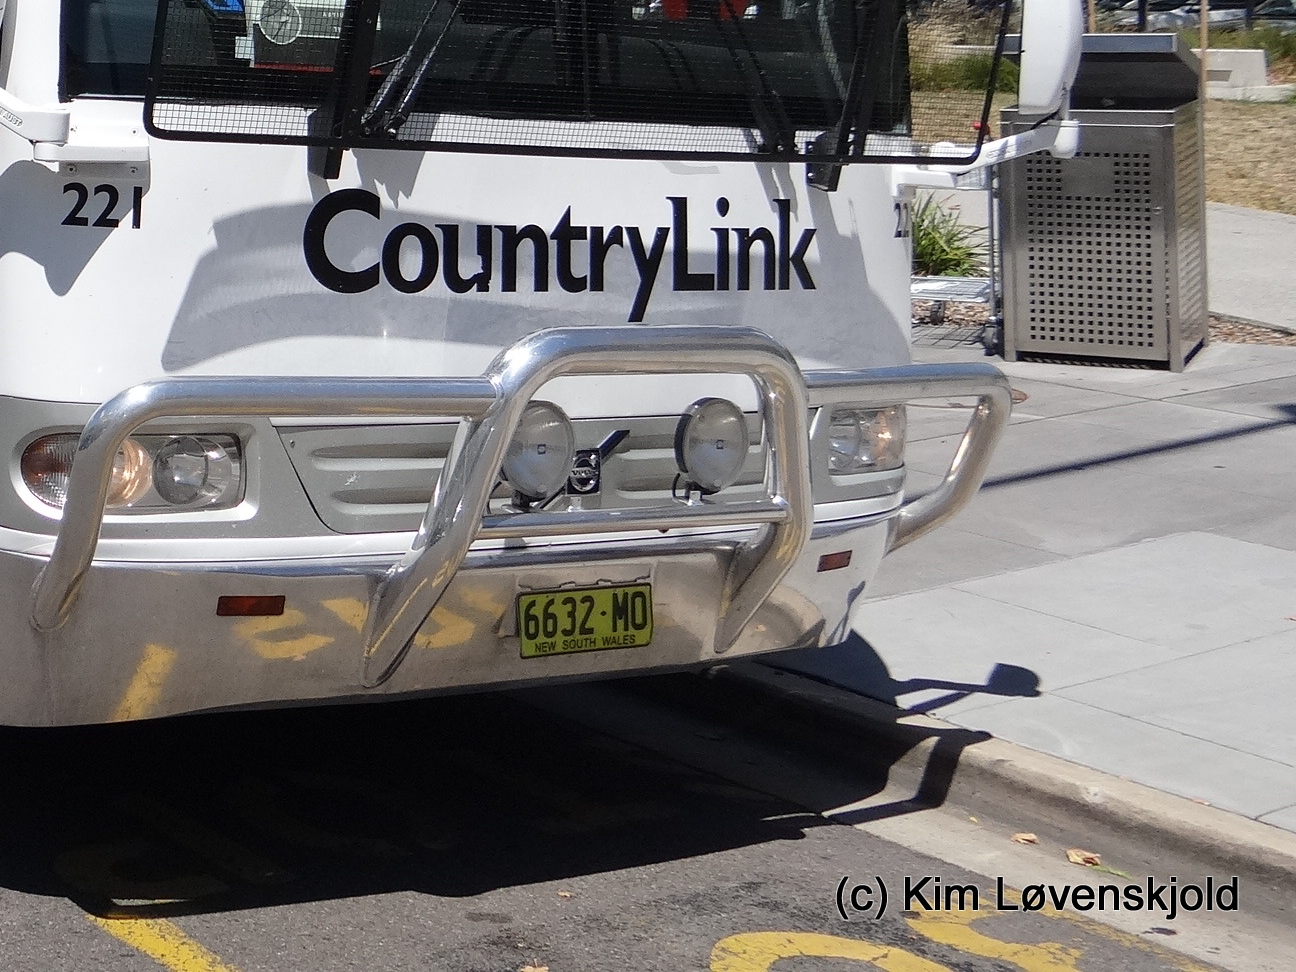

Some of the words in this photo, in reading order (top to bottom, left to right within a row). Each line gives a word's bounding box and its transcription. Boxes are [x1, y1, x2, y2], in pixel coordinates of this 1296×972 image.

[61, 182, 143, 229] 221
[304, 188, 817, 322] CountryLink
[534, 641, 556, 653] NEW
[562, 638, 597, 650] SOUTH
[602, 634, 636, 646] WALES
